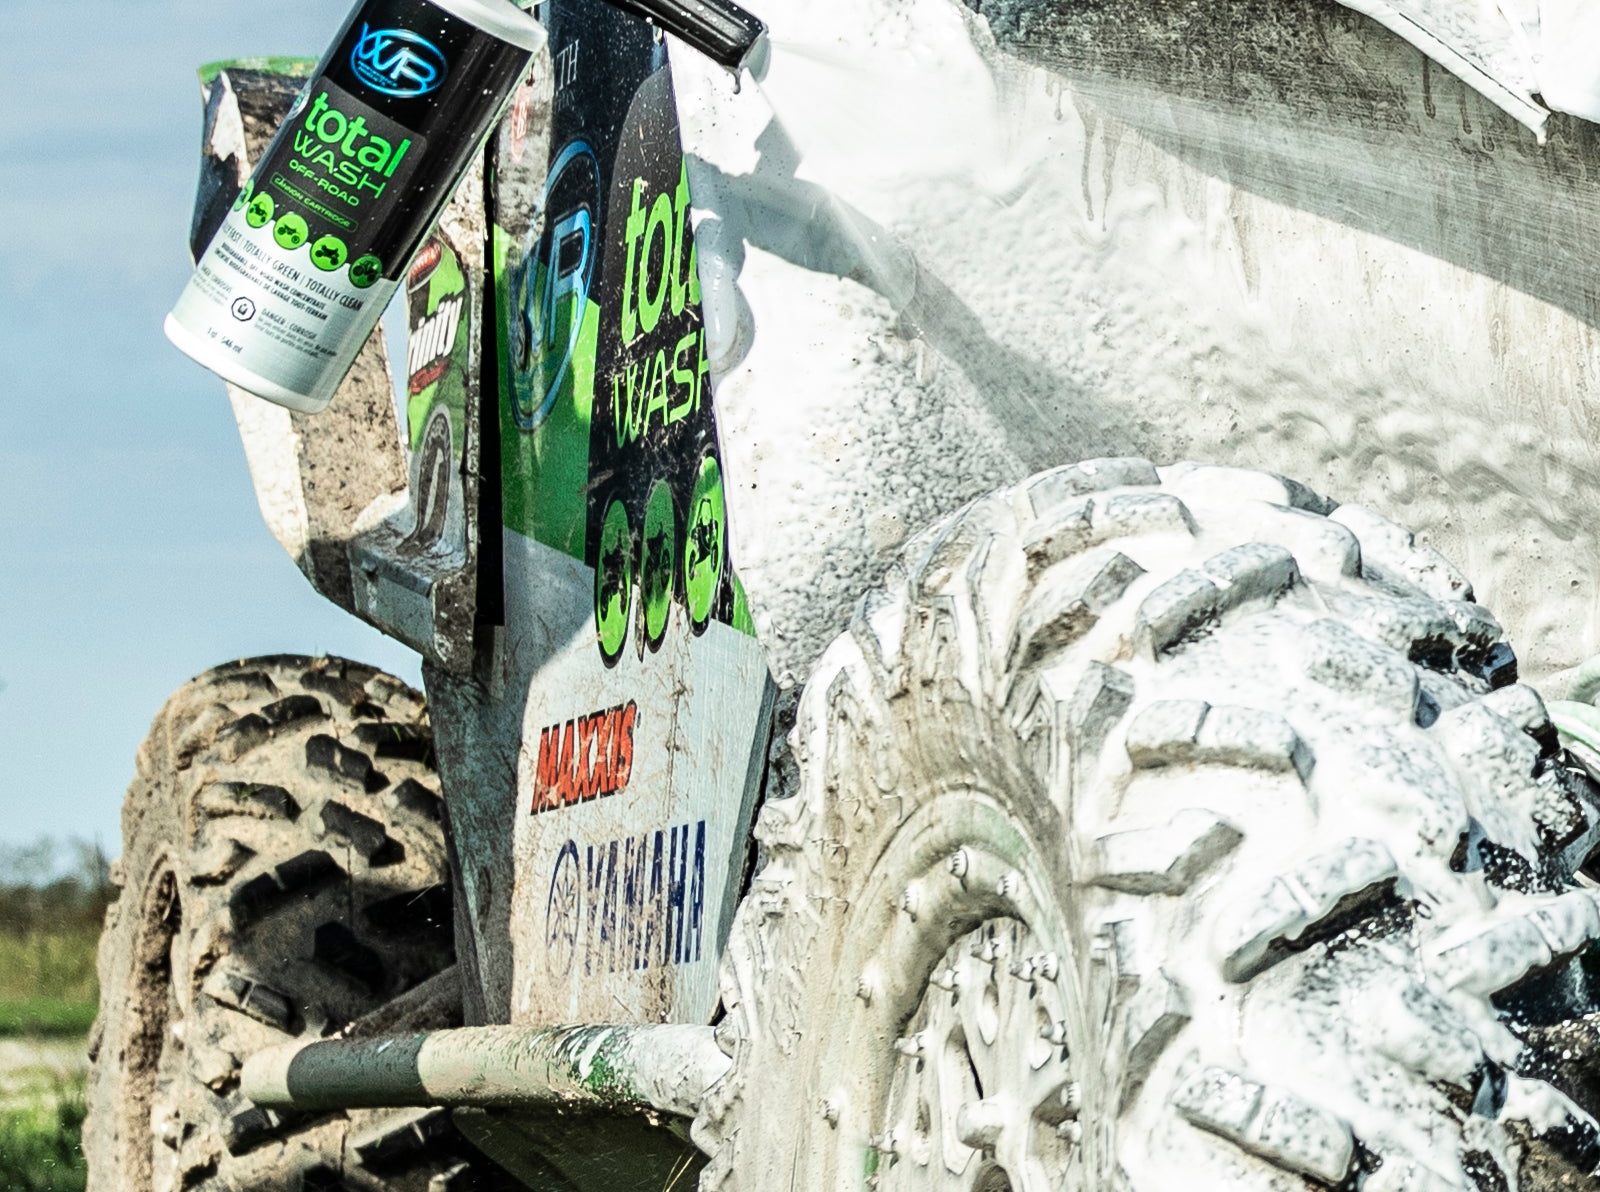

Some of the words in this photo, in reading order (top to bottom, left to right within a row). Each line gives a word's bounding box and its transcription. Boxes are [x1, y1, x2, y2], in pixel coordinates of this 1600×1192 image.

[293, 129, 387, 199] WASH
[304, 91, 412, 178] total
[287, 158, 360, 207] OFF-ROAD
[242, 239, 272, 265] TOTALLY
[271, 259, 300, 281] GREEN
[304, 277, 340, 301] TOTALLY
[338, 293, 364, 312] CLEAN
[530, 697, 638, 816] MAXXIS
[585, 819, 707, 977] YAMAHA
